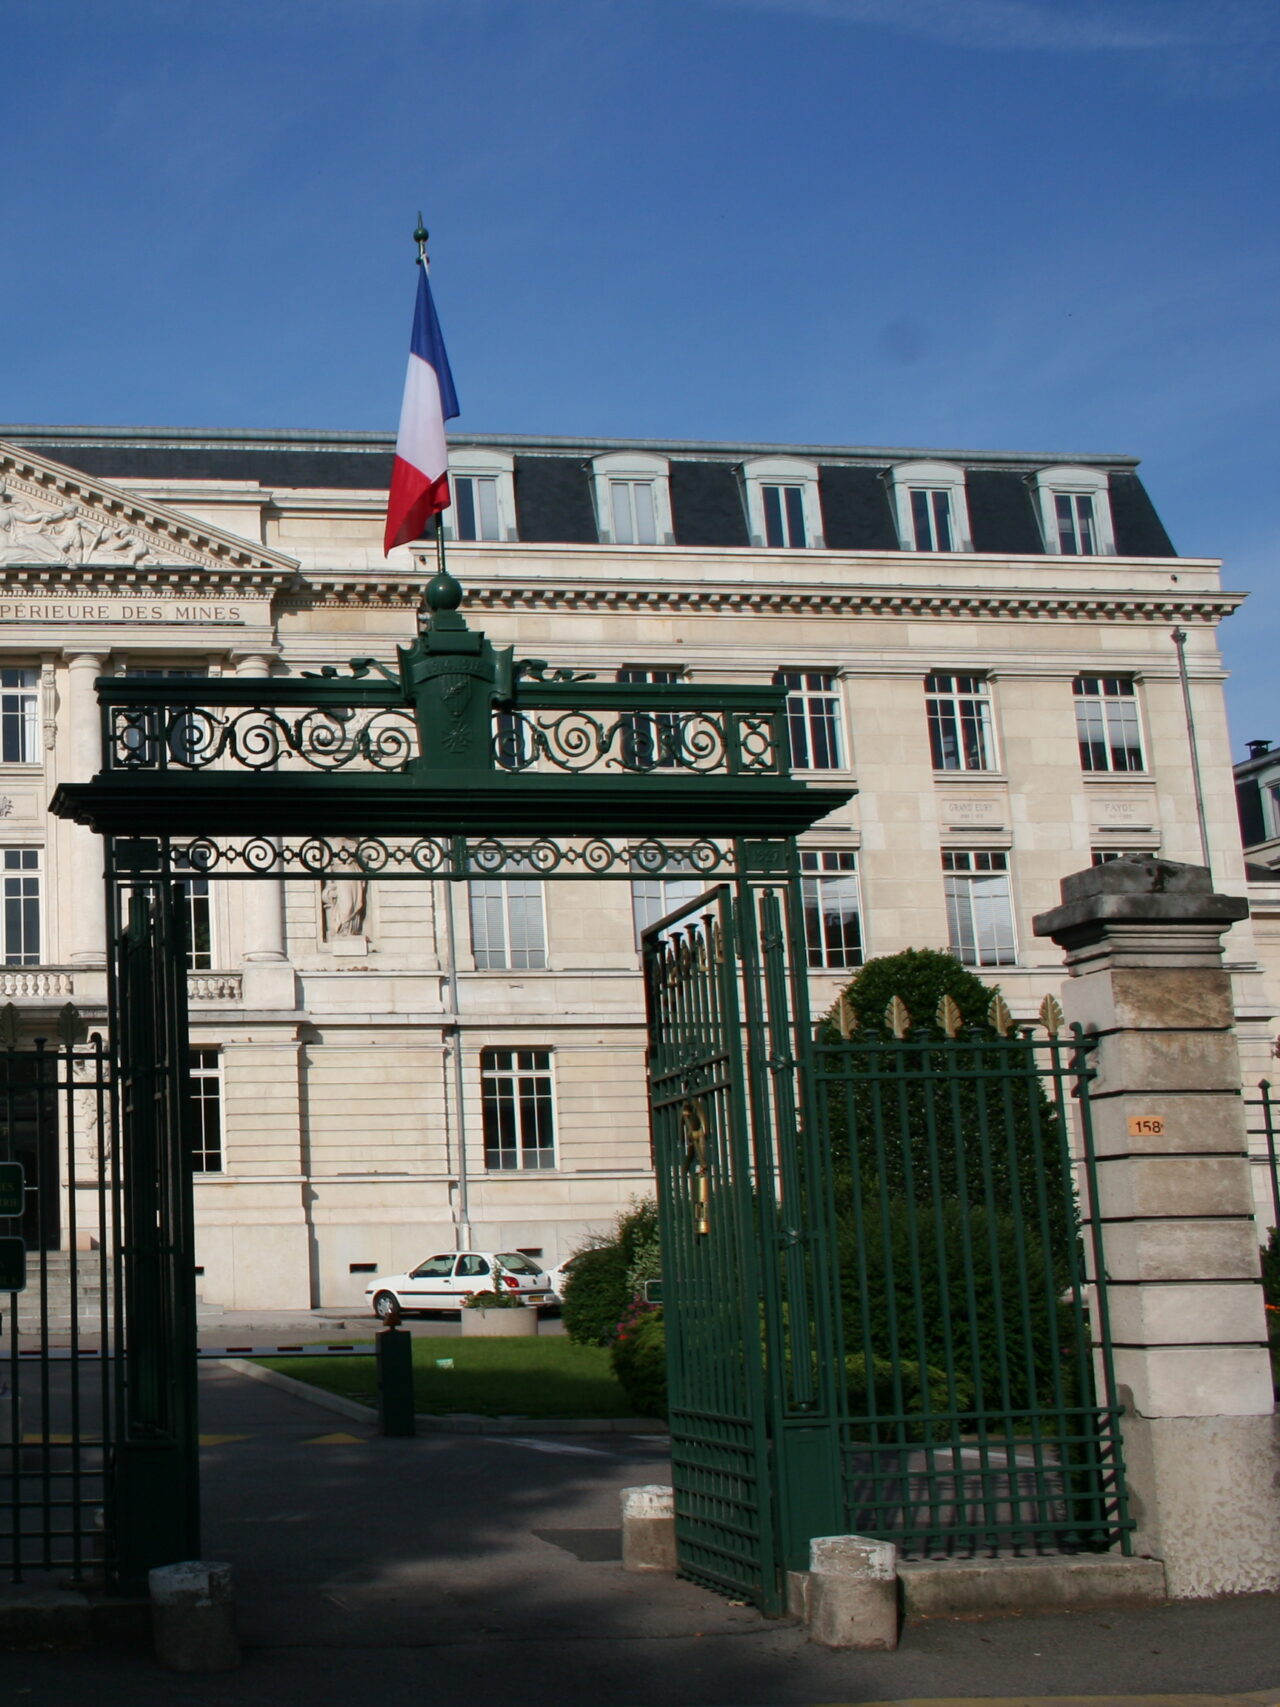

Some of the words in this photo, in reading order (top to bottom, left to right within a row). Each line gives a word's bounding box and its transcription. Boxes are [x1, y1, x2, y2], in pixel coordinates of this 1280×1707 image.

[121, 606, 163, 620] DES
[176, 606, 241, 621] MINES
[1104, 803, 1136, 813] FAYOL
[1136, 1120, 1161, 1133] 158
